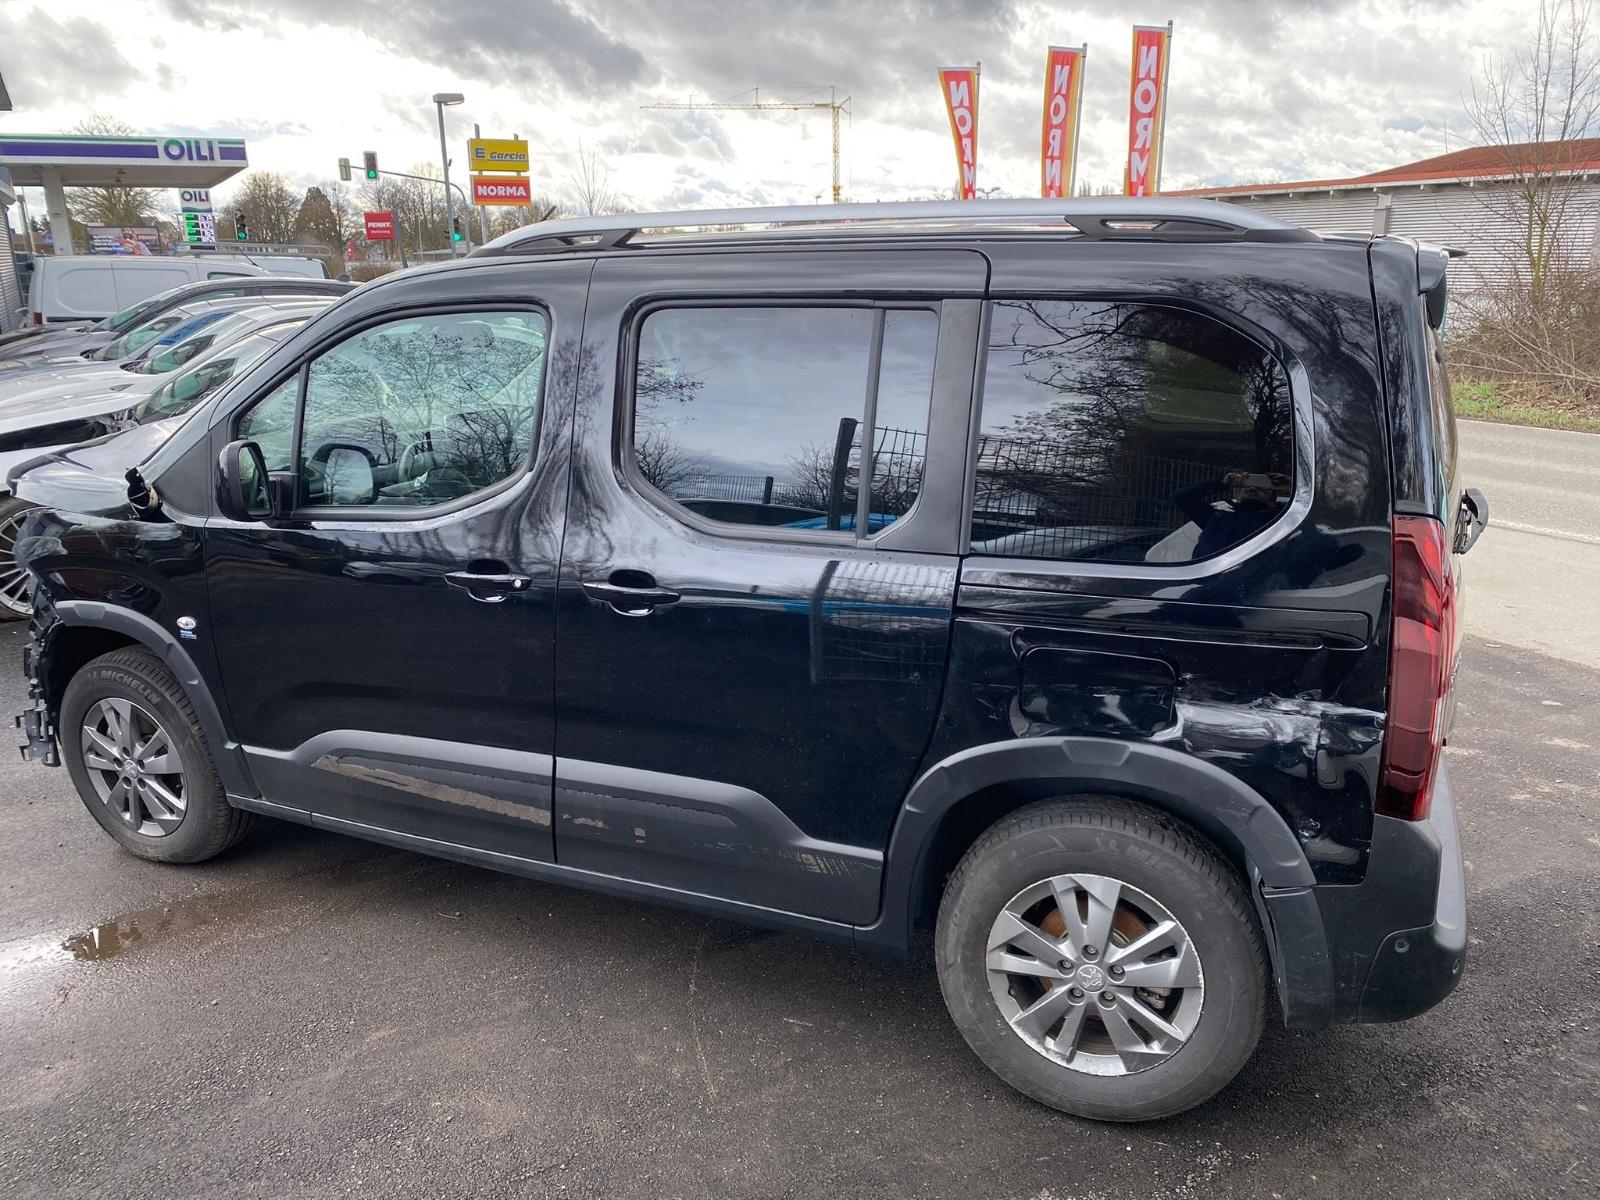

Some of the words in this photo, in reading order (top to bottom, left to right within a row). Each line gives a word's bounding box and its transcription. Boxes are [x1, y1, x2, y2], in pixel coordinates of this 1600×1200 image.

[163, 139, 215, 161] OILI
[490, 152, 526, 160] Garcia
[181, 190, 209, 202] OILI
[477, 185, 526, 196] NORMA
[101, 670, 161, 705] MICHELIN
